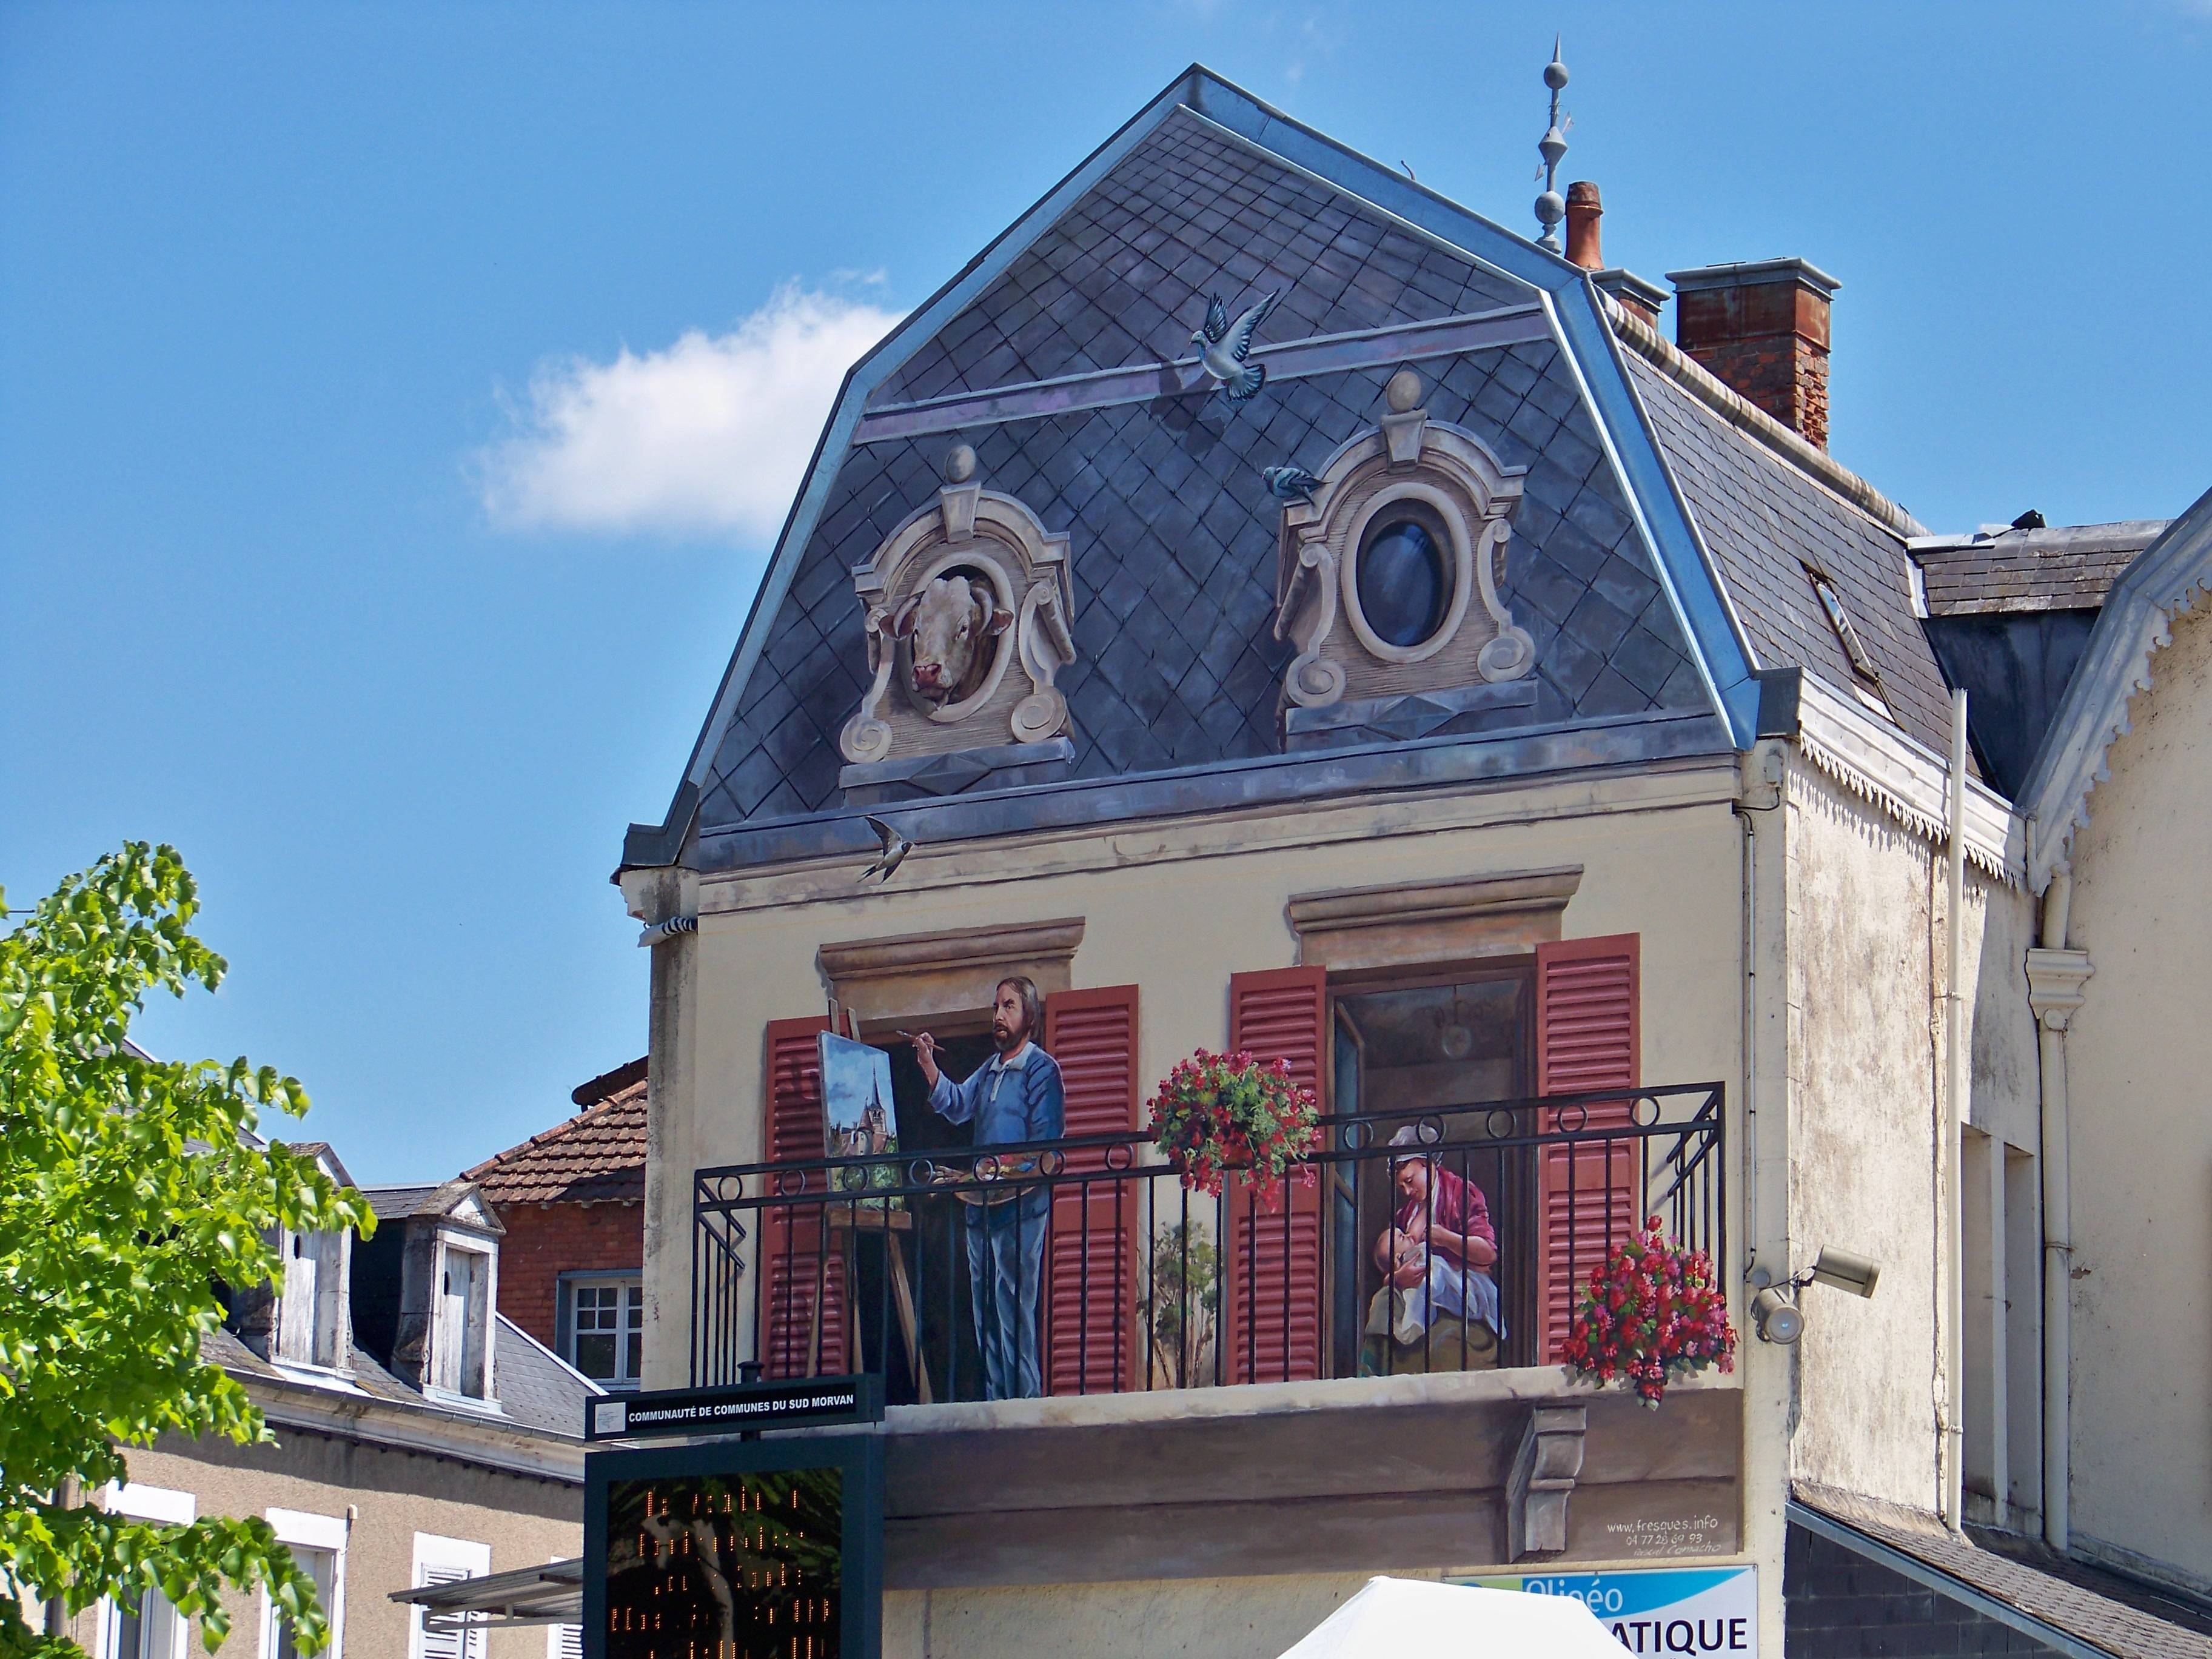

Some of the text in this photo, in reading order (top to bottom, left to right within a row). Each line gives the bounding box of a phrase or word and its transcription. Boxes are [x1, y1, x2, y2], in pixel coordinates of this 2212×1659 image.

[629, 1394, 854, 1423] COMMUNAUTÉ DE COMMUNES DU SUD MORVAN
[1607, 1515, 1718, 1535] www.fresques.info
[1626, 1535, 1638, 1546] 04
[1641, 1535, 1654, 1545] 77
[1671, 1533, 1684, 1544] 69
[1689, 1533, 1703, 1544] 93
[1666, 1540, 1722, 1555] Camacho
